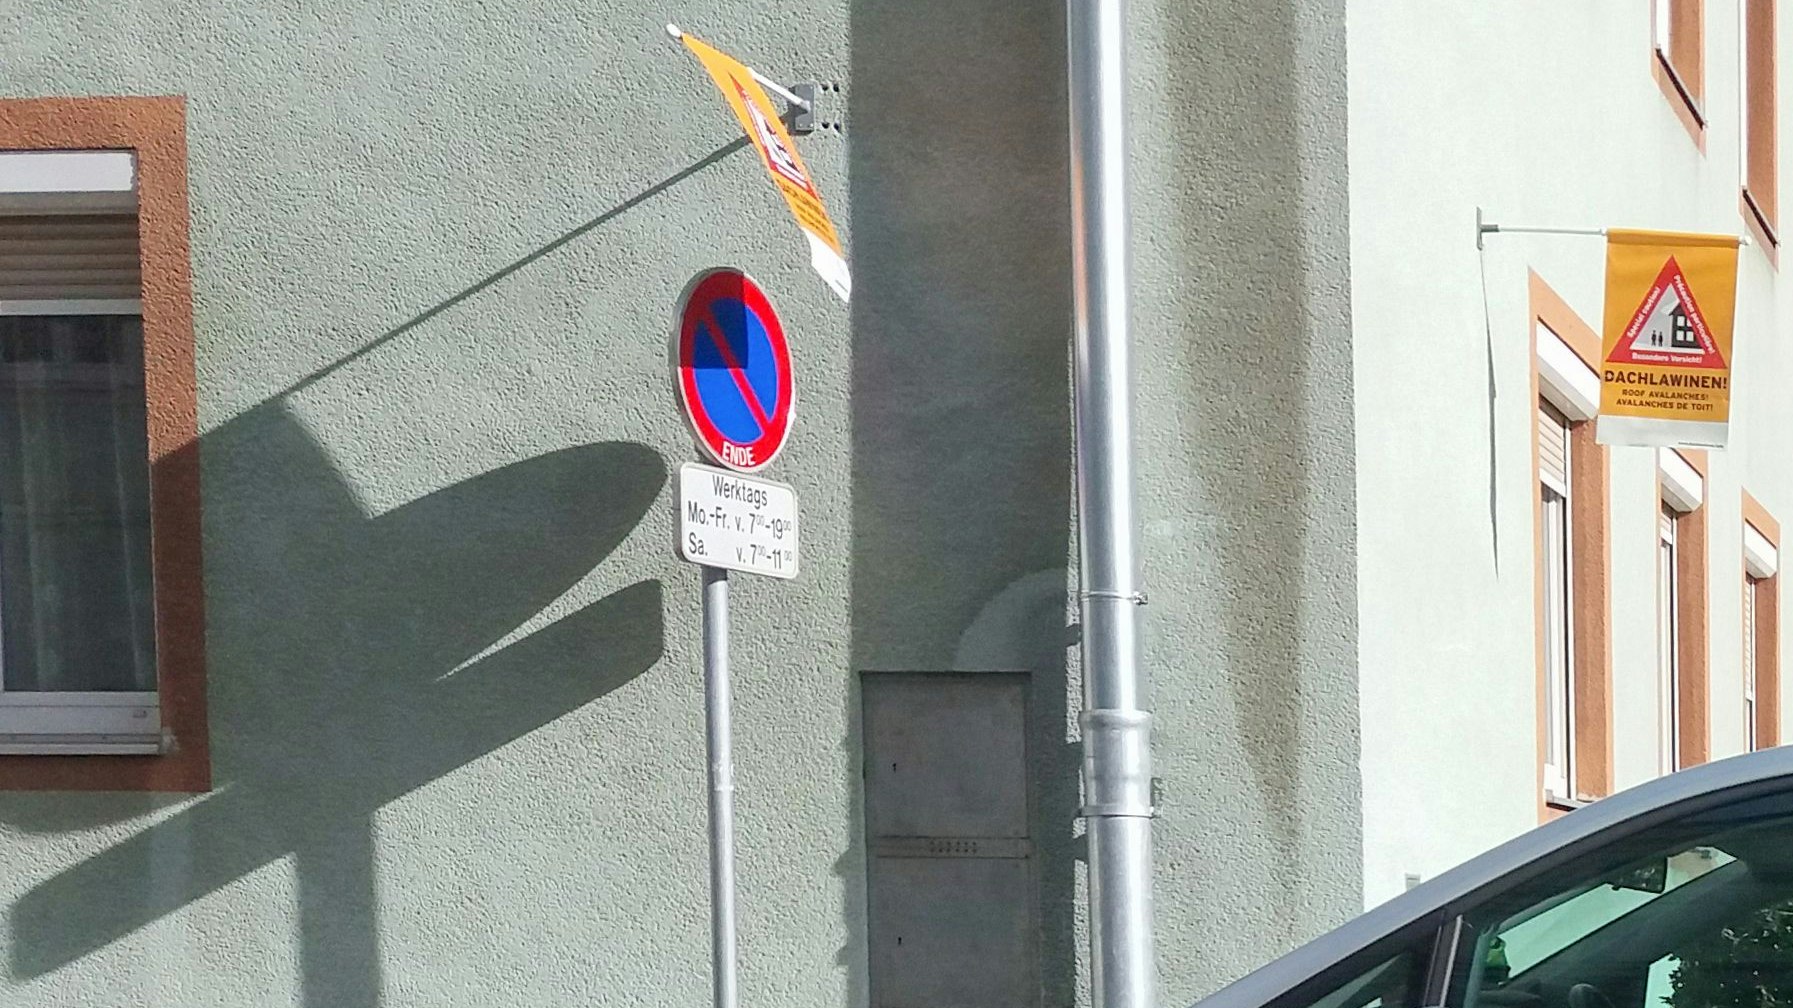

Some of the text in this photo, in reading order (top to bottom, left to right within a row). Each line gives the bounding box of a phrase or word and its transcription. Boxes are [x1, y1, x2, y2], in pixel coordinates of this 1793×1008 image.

[1604, 370, 1728, 389] DACHLAWINEN!
[1622, 389, 1709, 401] ROOF AVALANCHES!
[1616, 398, 1713, 412] AVALANCHES DE TOIT!
[722, 440, 756, 466] ENDE
[712, 474, 768, 510] Werktags
[735, 516, 745, 532] v.
[688, 531, 708, 556] Sa.
[736, 547, 747, 564] v.
